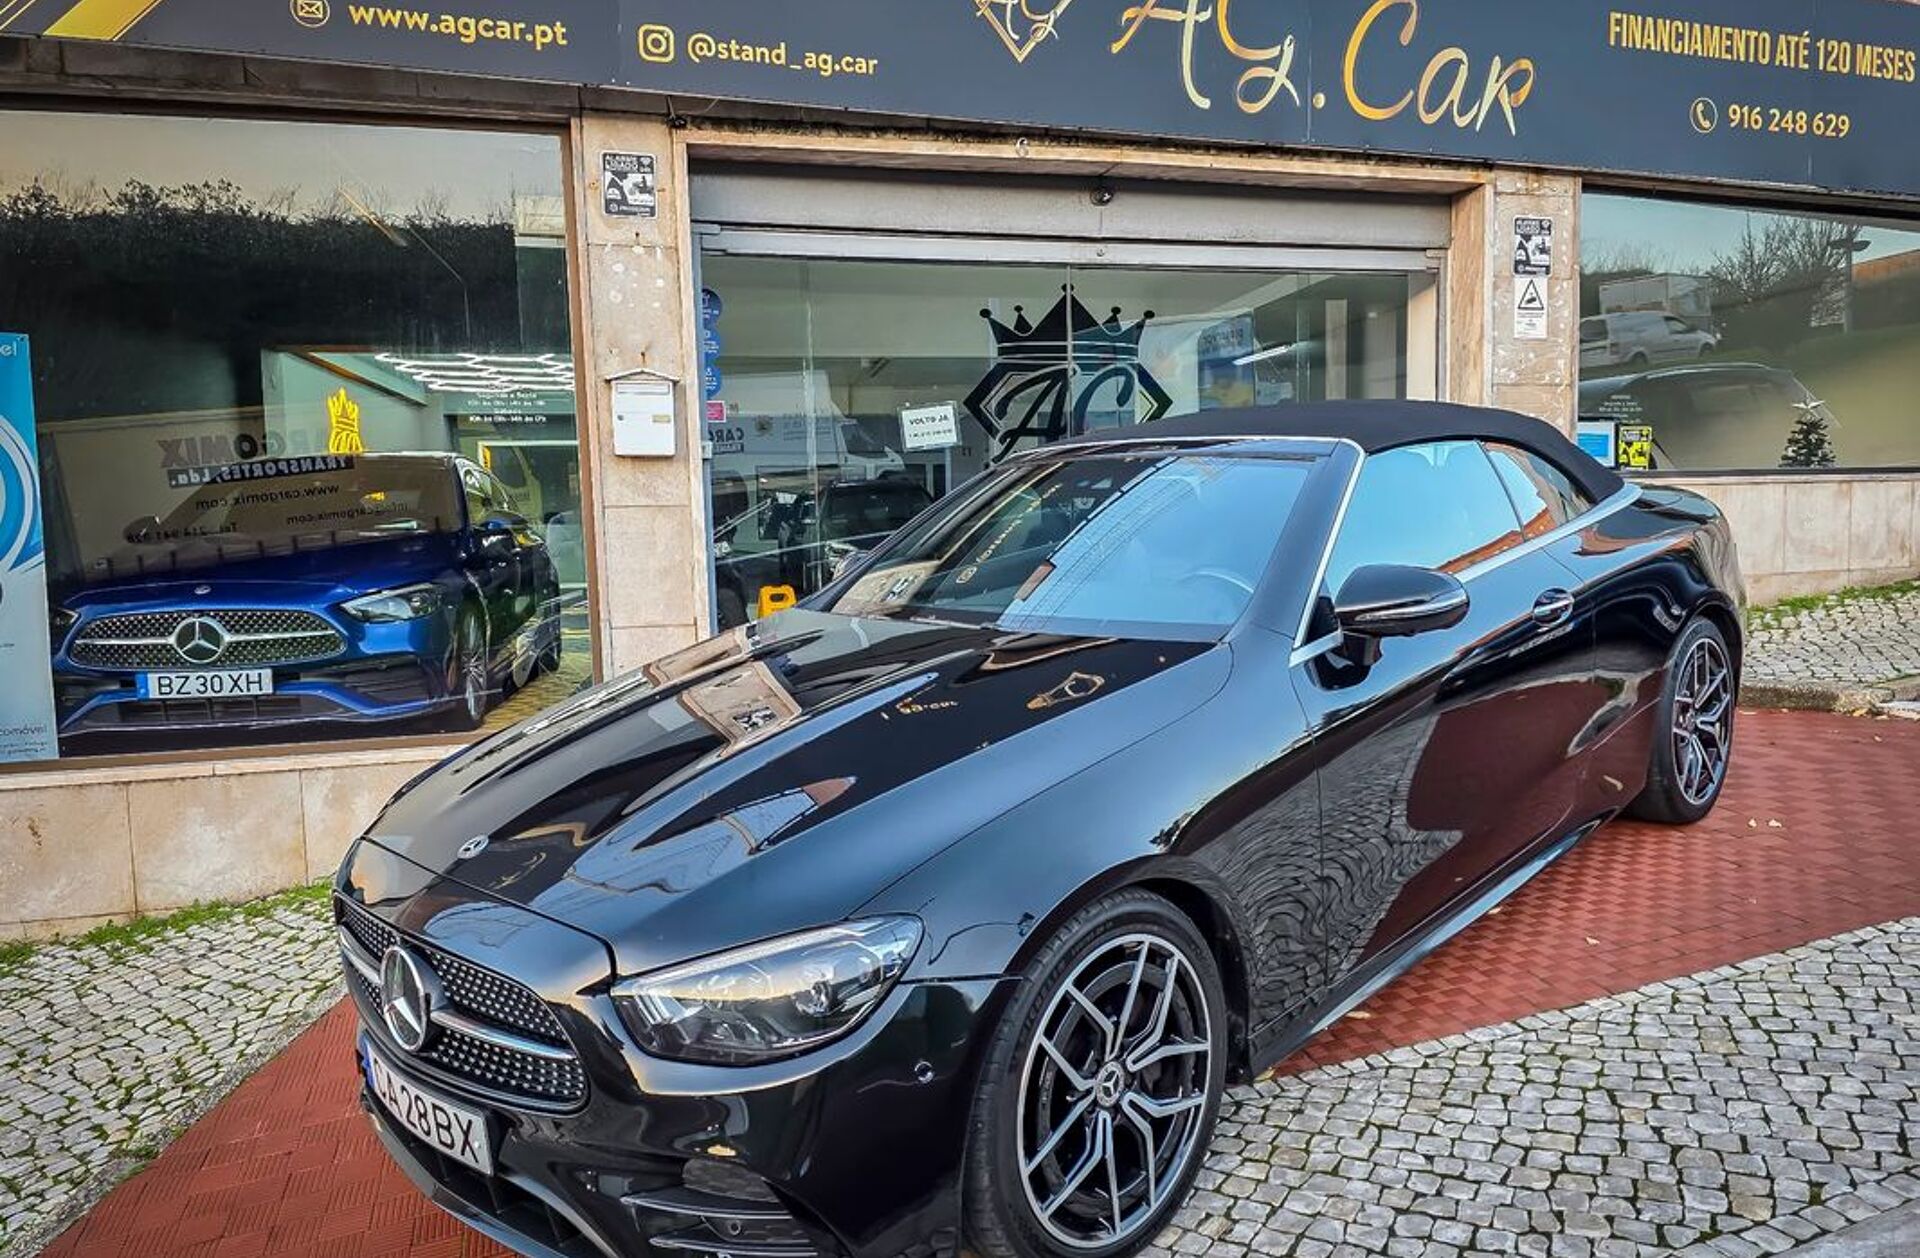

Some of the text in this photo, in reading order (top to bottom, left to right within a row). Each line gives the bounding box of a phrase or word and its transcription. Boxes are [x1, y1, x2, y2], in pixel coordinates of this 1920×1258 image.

[349, 4, 568, 50] www.agcar.pt
[1609, 11, 1916, 82] FINANCIAMENTO ATÉ 120 MESES
[687, 33, 878, 77] @stand_ag.car
[1728, 104, 1850, 138] 916 248 629
[0, 341, 17, 357] el
